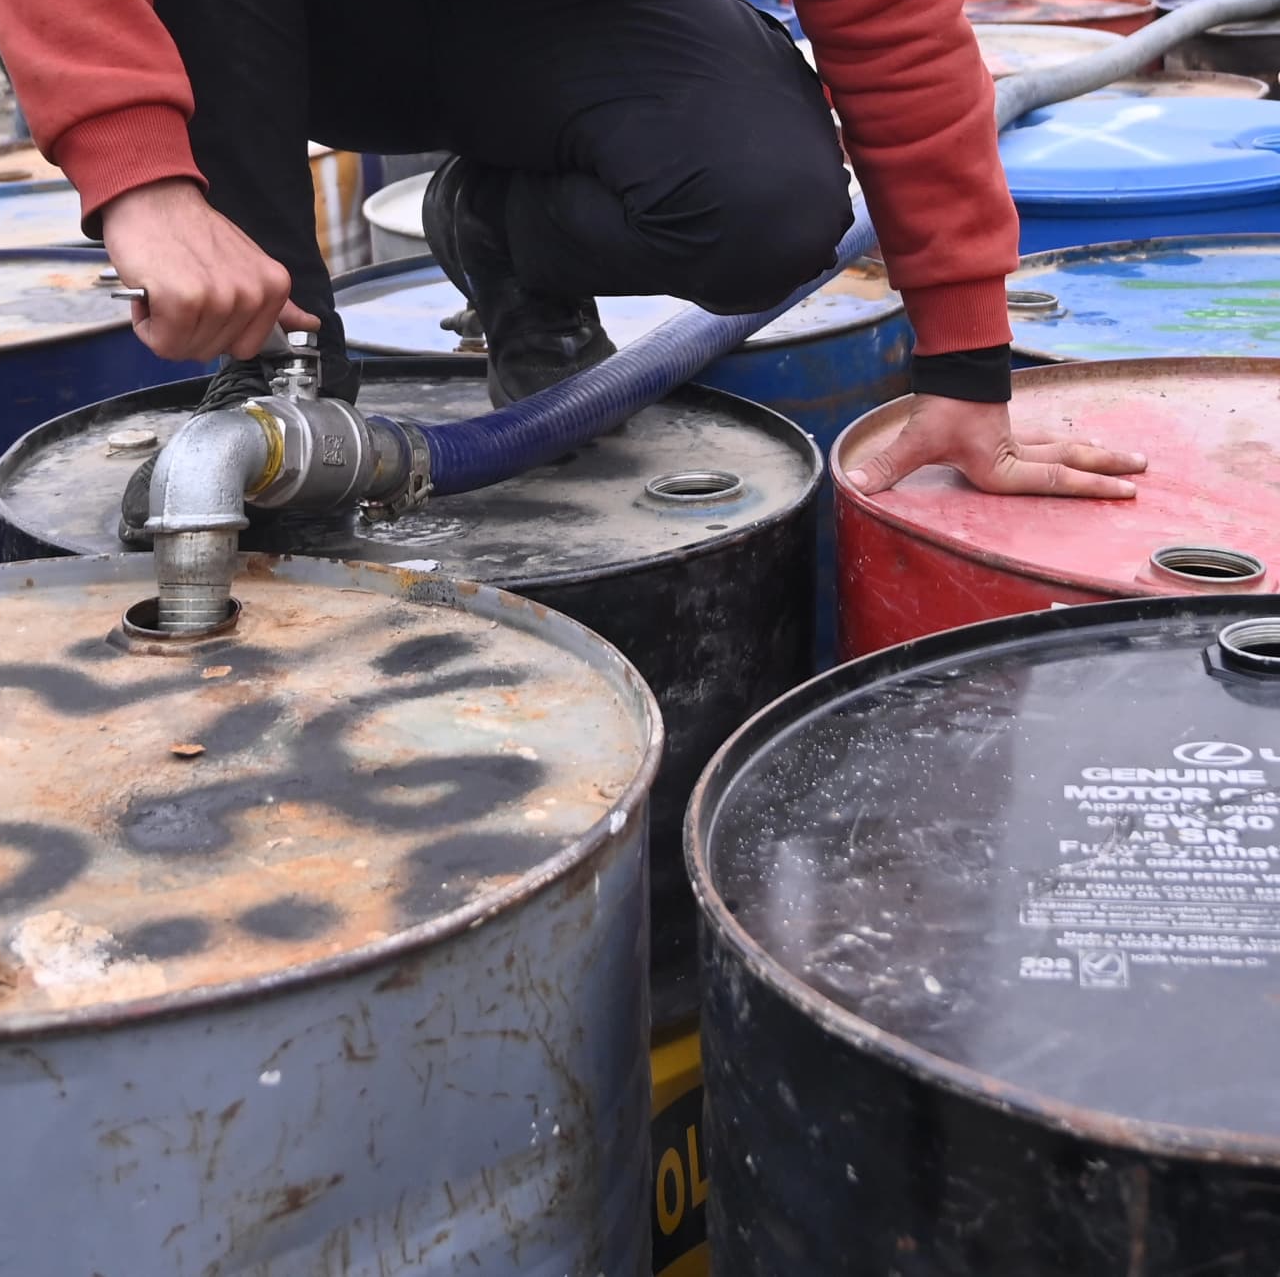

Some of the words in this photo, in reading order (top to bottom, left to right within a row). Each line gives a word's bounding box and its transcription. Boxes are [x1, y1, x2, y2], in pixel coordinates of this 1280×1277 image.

[1081, 767, 1268, 785] GENUINE
[1063, 785, 1213, 803] MOTOR
[1078, 801, 1175, 815] Approved
[1143, 813, 1275, 831] 5W-40
[1129, 830, 1165, 843] API
[1177, 827, 1240, 845] SN
[1191, 872, 1260, 883] PETROL
